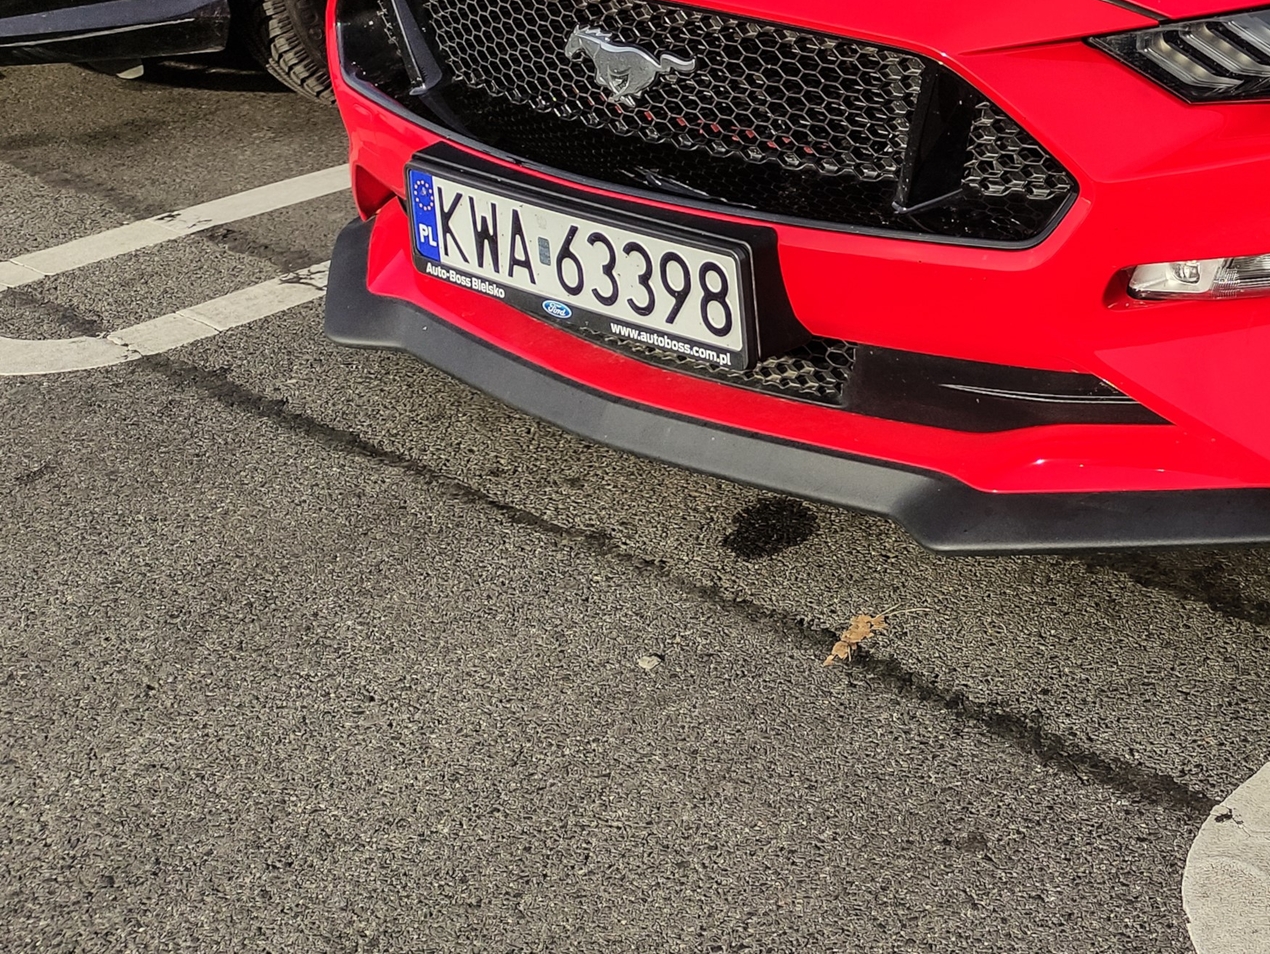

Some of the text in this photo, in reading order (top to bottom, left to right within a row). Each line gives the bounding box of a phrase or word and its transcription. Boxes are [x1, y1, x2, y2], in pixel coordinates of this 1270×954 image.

[418, 223, 438, 247] PL
[426, 262, 505, 299] Auto-Boss Bielsko
[437, 186, 733, 337] KWA 63398
[610, 322, 732, 366] www.autoboss.com.pl
